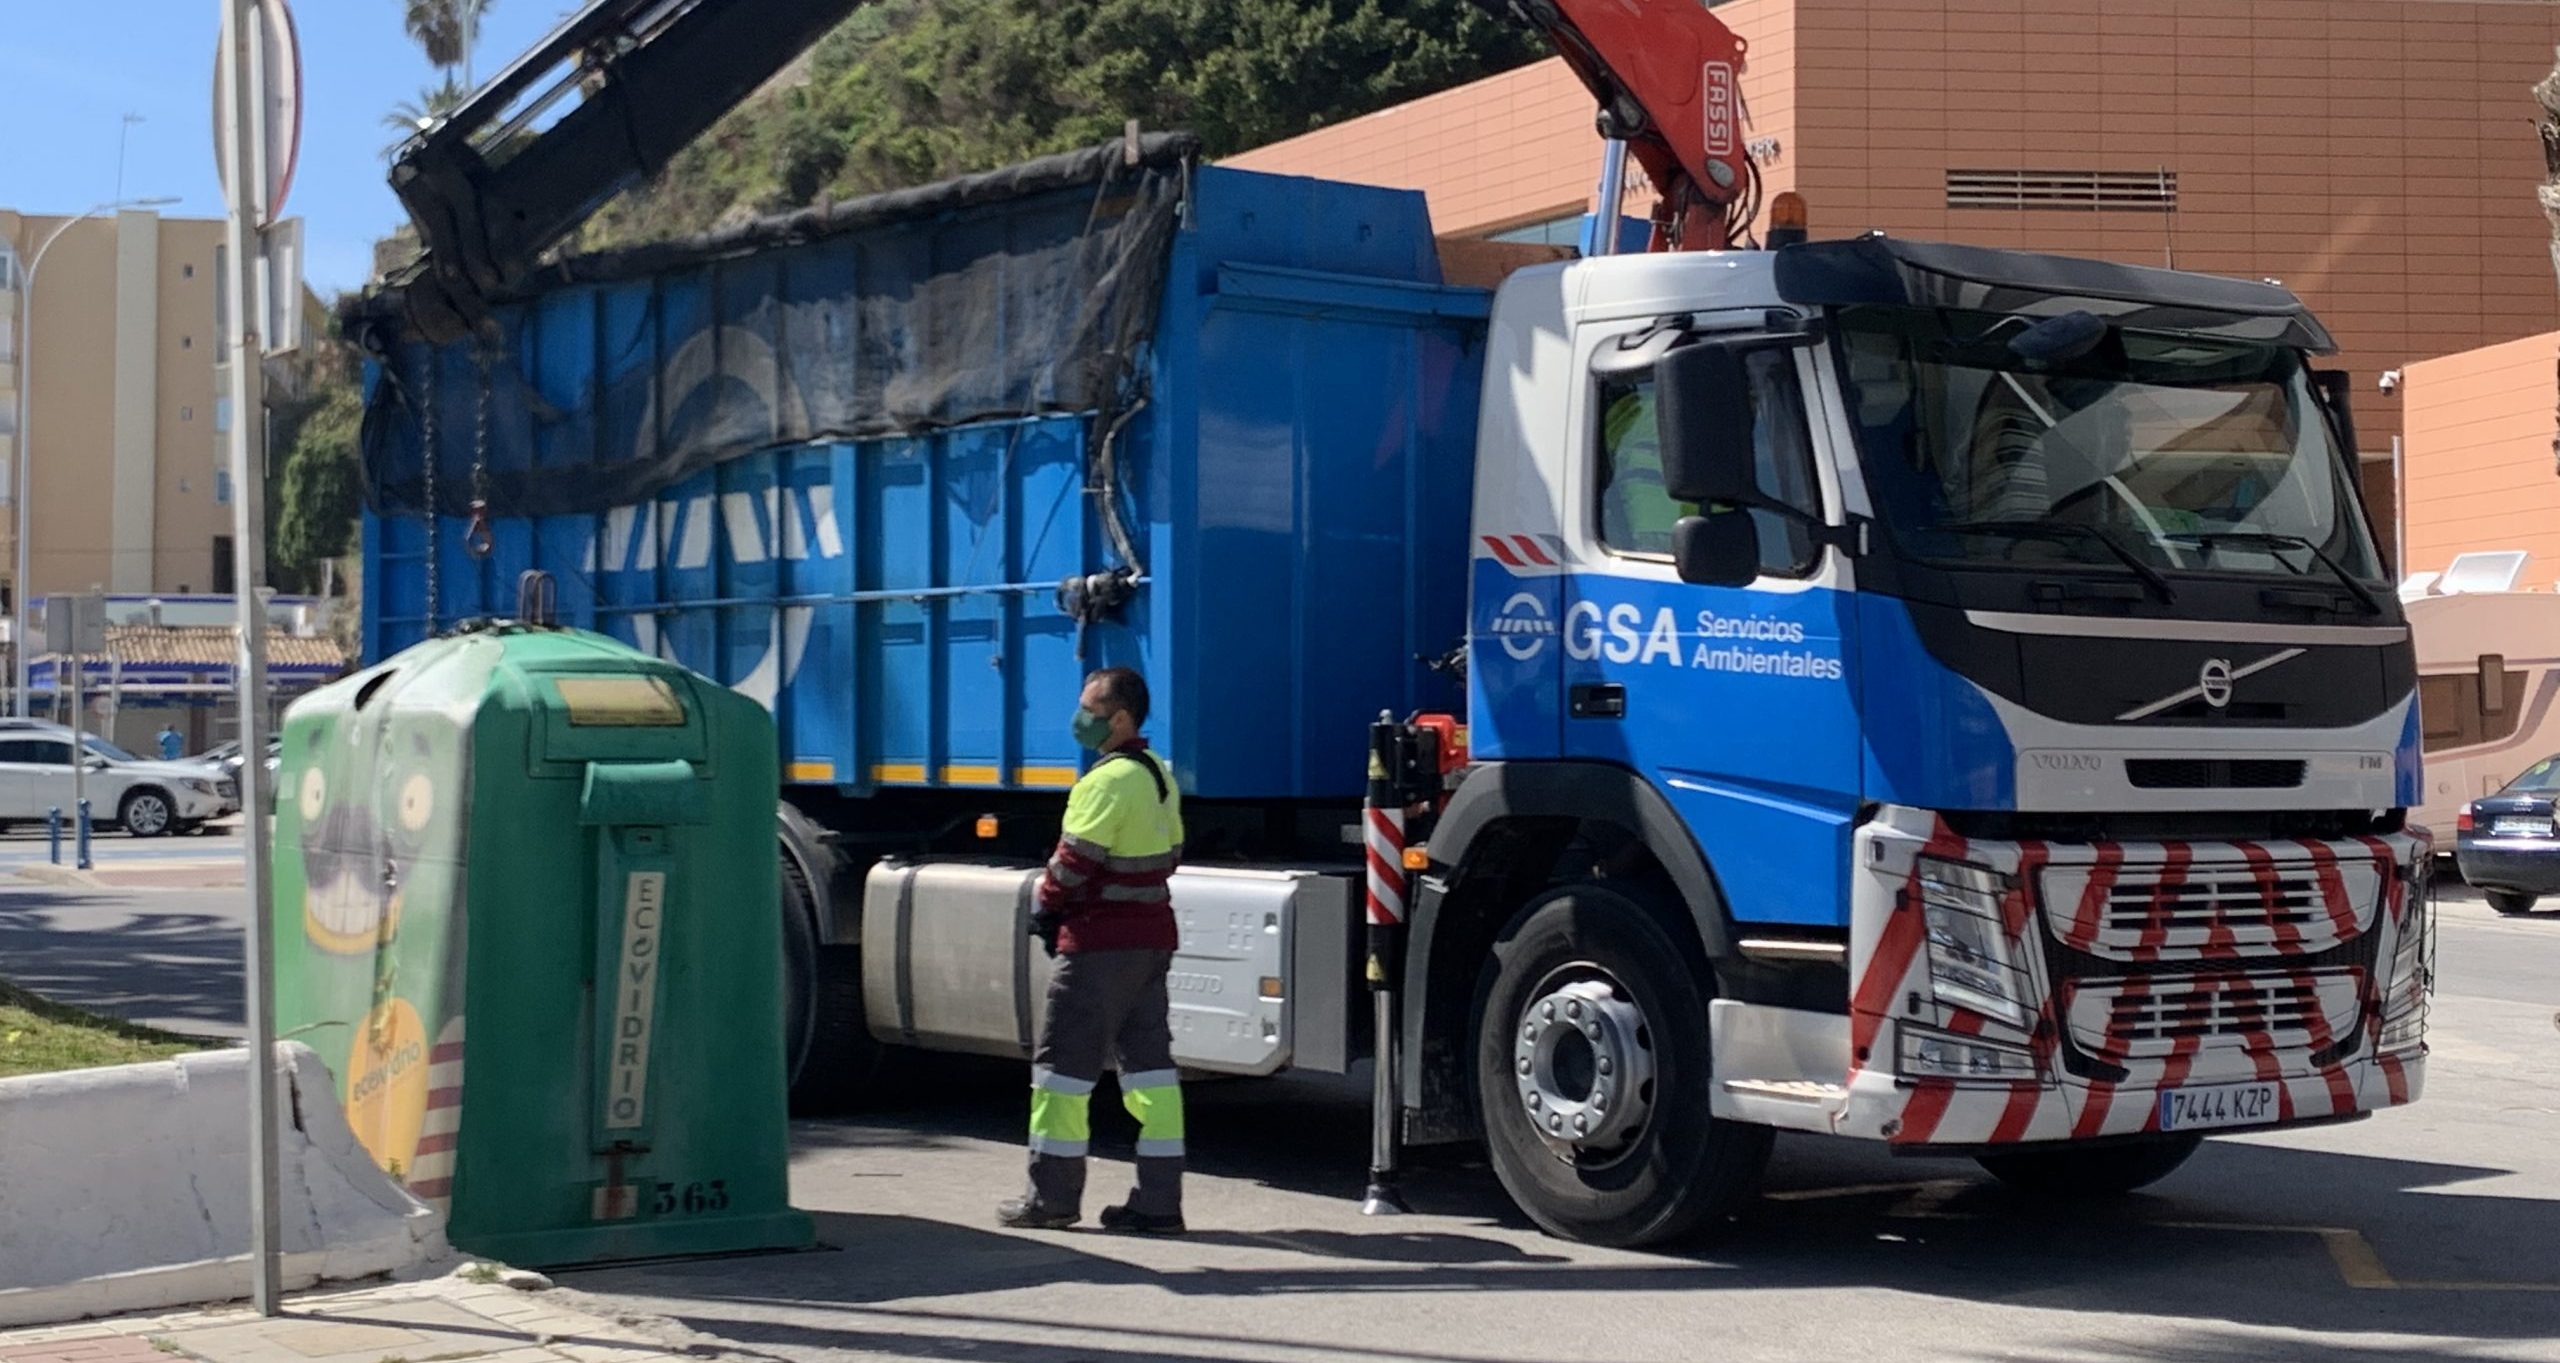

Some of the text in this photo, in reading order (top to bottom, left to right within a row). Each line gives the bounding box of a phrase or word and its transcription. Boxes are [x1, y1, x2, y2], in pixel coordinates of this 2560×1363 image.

[1708, 68, 1727, 147] FASSI
[1563, 600, 1683, 667] GSA
[1696, 609, 1804, 643] Servicios
[1691, 643, 1842, 680] Ambientales
[2031, 754, 2102, 771] VOLVO
[612, 878, 656, 1121] ECOVIDRIO
[1165, 971, 1224, 994] OLVO
[2174, 1087, 2272, 1124] 7444 KZP
[653, 1179, 730, 1216] 363
